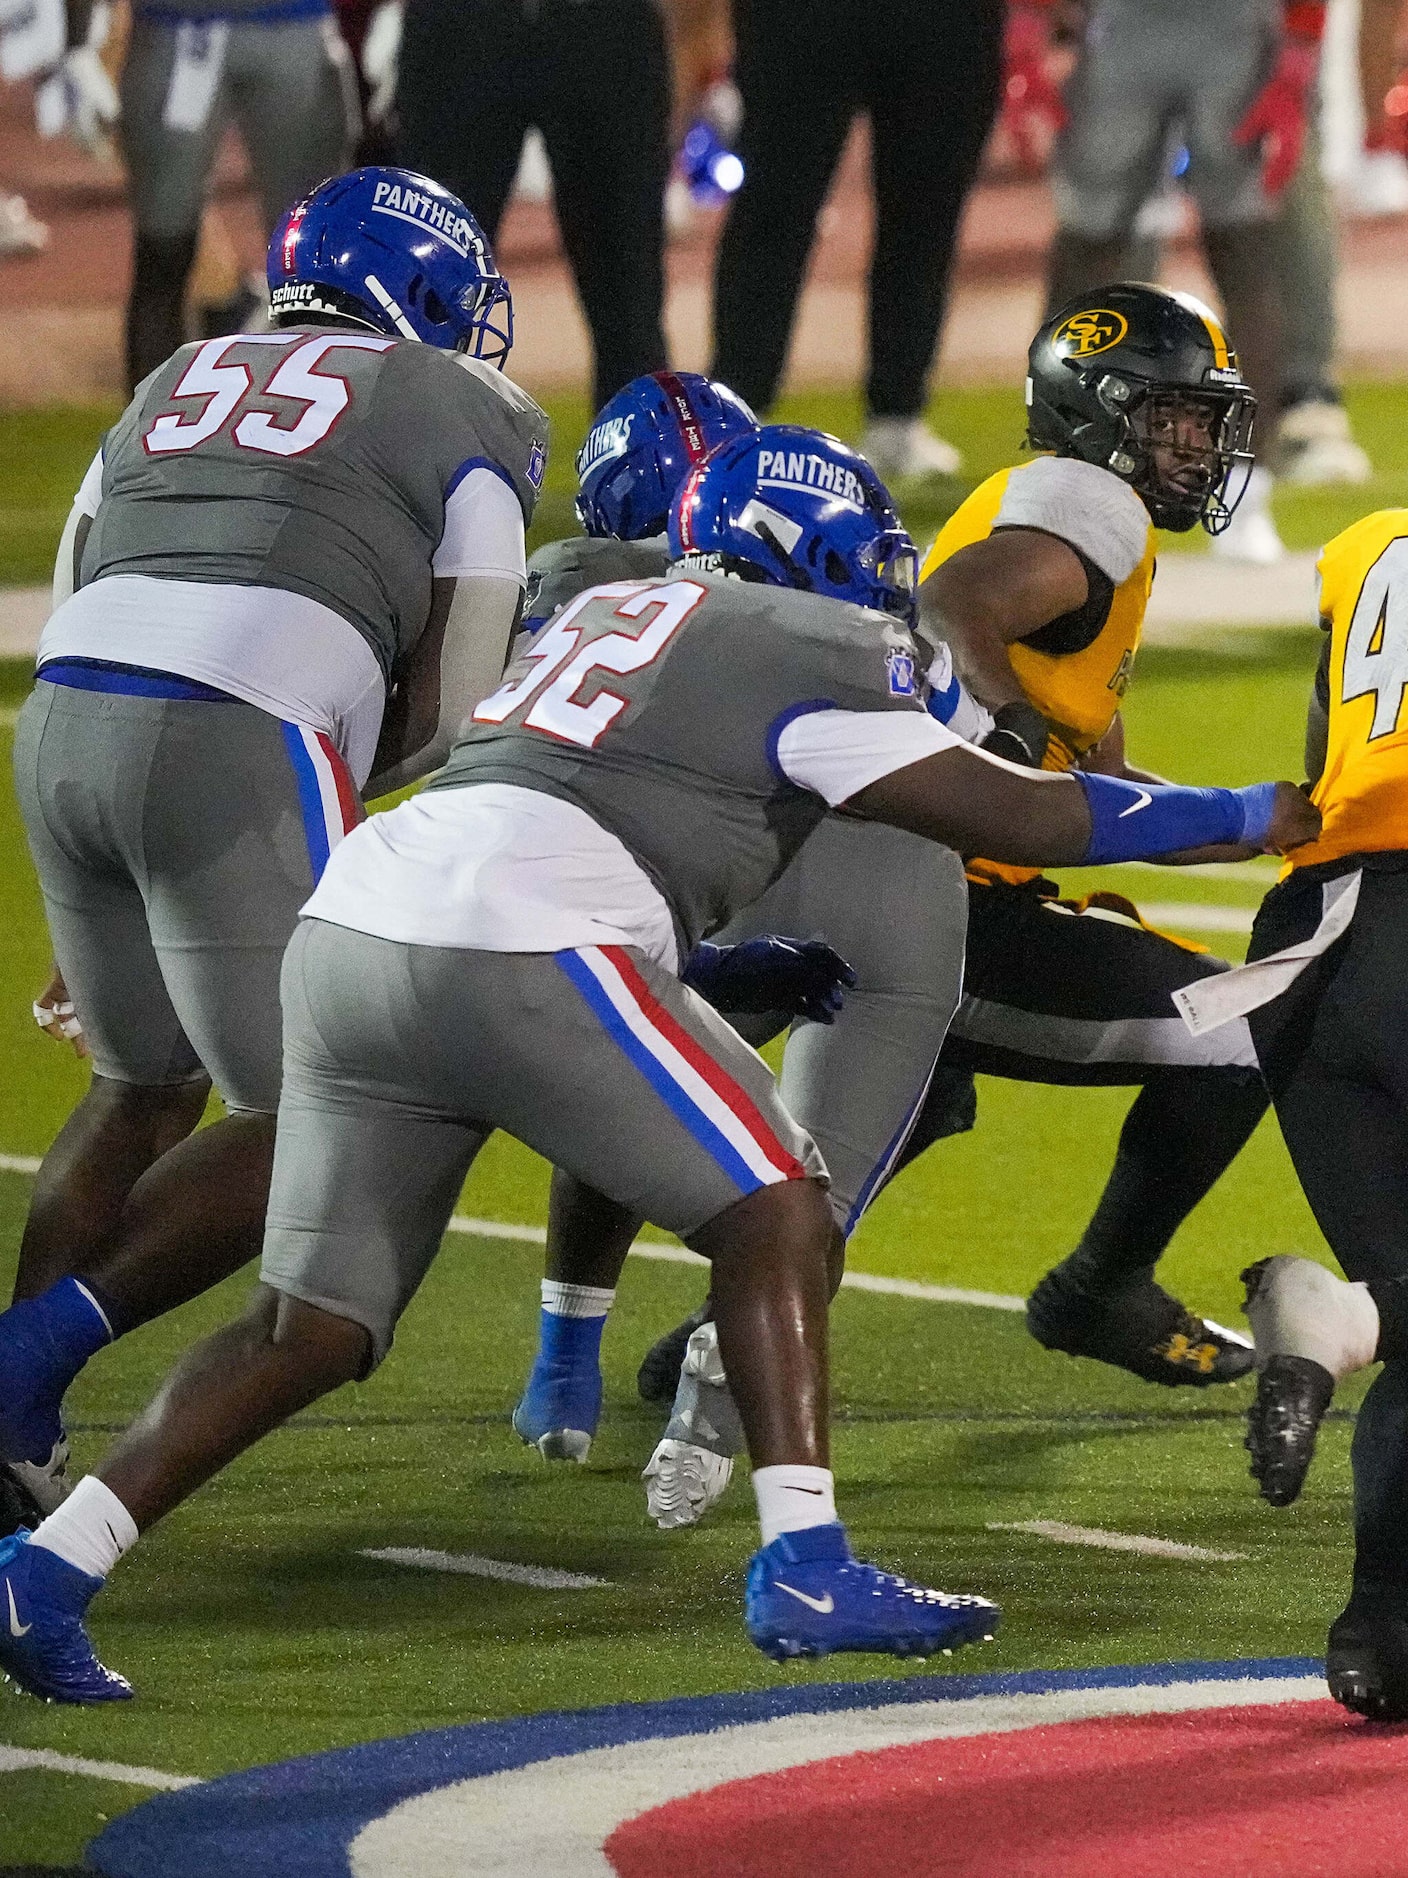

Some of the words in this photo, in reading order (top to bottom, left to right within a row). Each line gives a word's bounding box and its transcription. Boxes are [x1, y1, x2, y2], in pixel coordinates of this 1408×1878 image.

[374, 182, 471, 251] PANTHERS
[272, 281, 315, 304] schutt
[143, 333, 399, 456] 55
[757, 450, 865, 504] PANTHERS
[471, 579, 709, 748] 52
